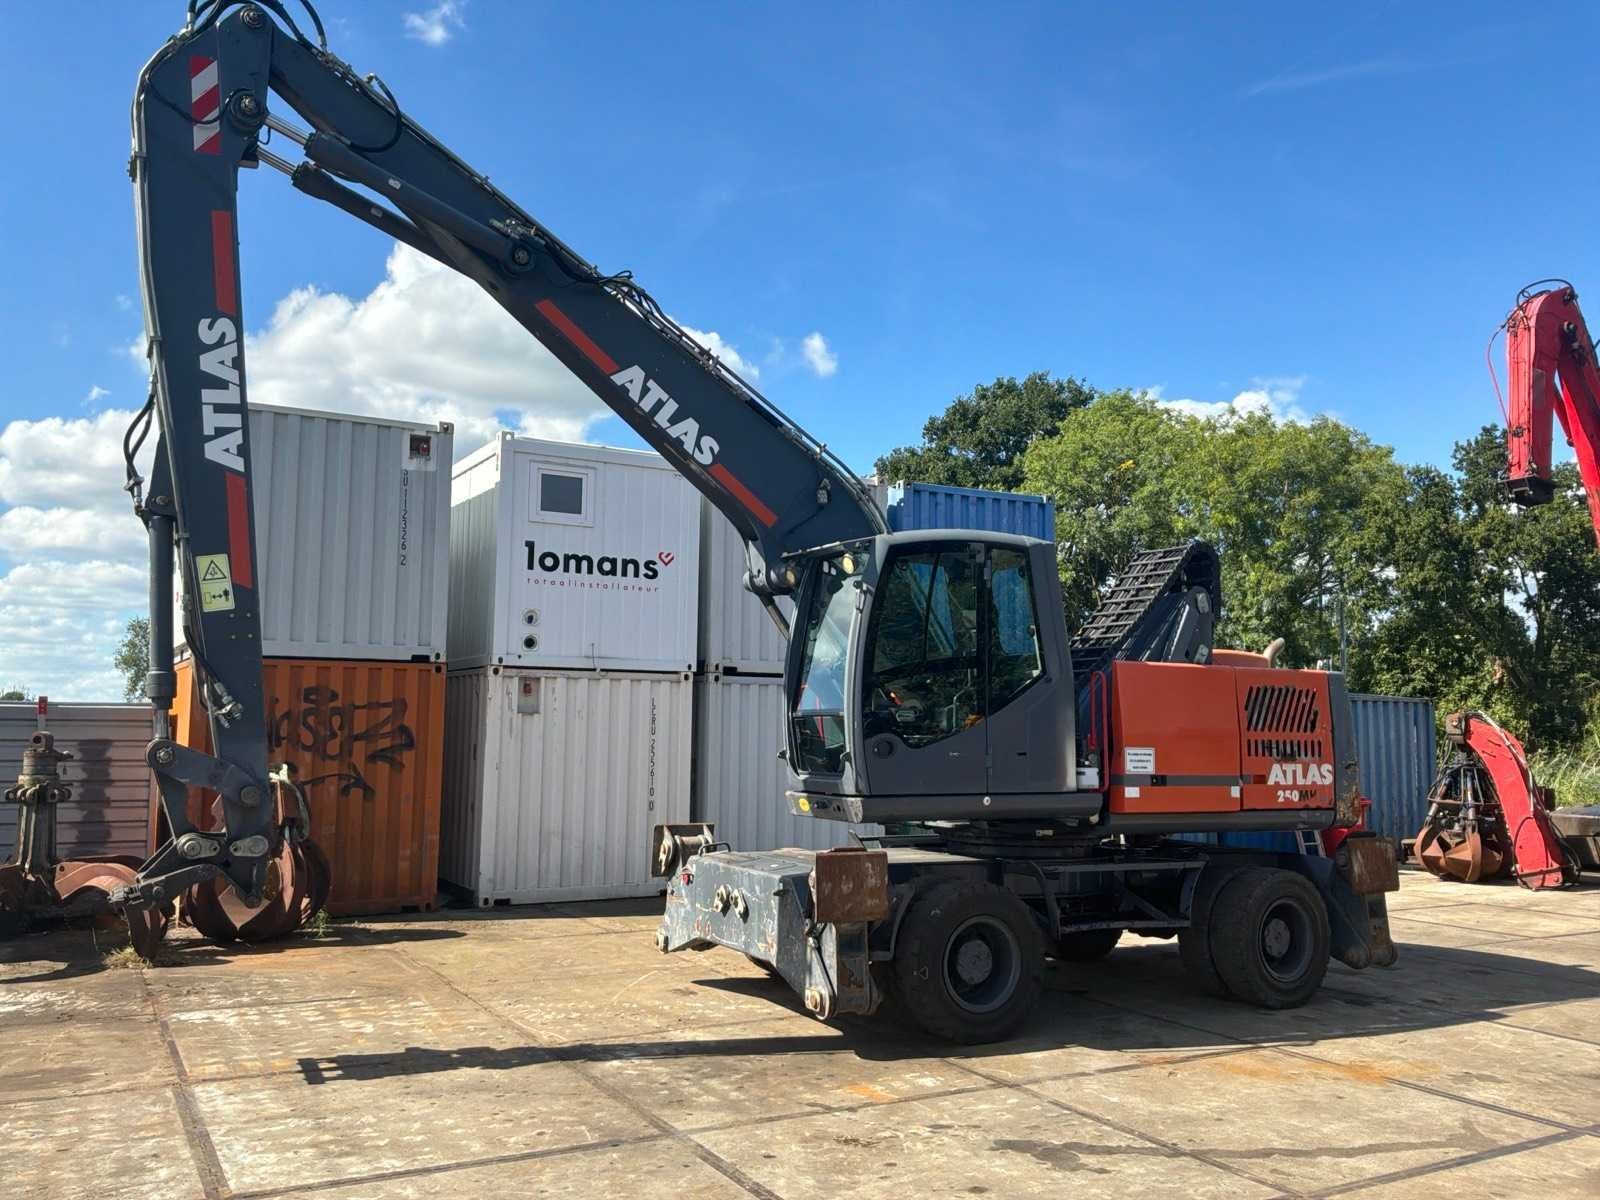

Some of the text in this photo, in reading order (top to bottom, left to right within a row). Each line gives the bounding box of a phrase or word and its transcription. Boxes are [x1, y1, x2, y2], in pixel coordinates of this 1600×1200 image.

[198, 317, 245, 472] ATLAS
[610, 365, 720, 465] ATLAS
[524, 540, 659, 580] lomans
[527, 578, 659, 592] totaalinstallateur
[1266, 763, 1334, 785] ATLAS
